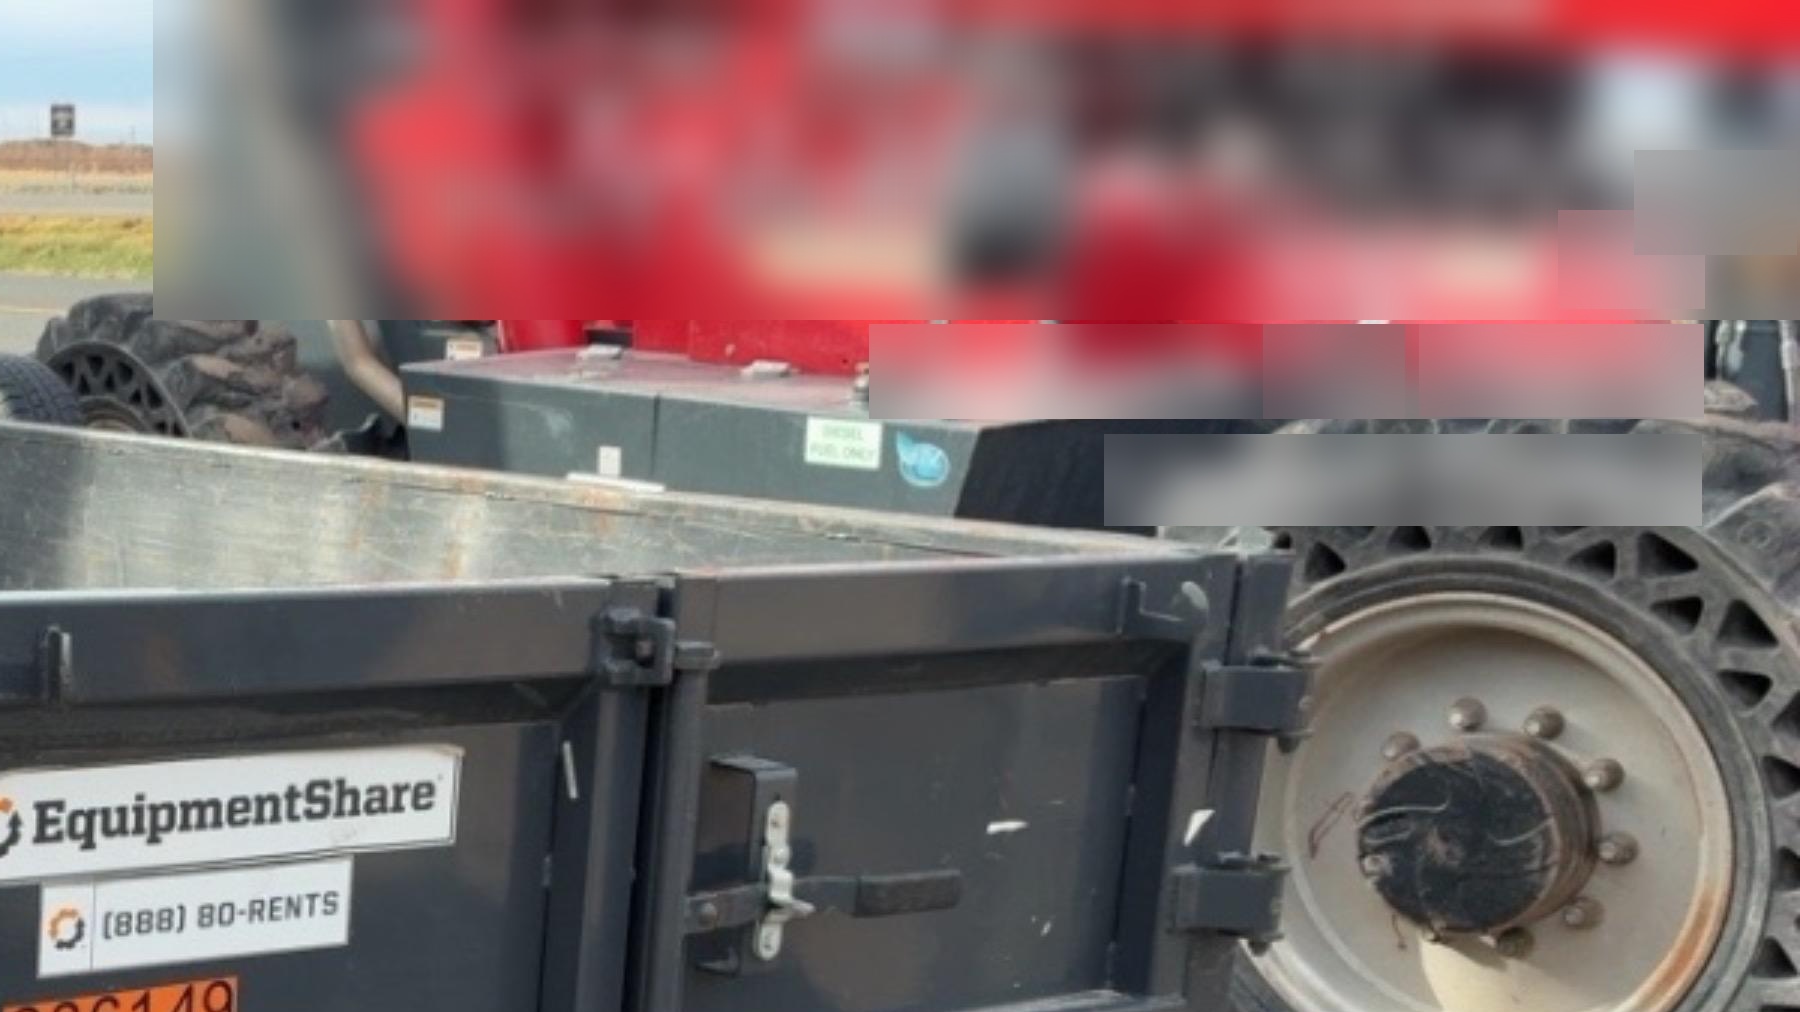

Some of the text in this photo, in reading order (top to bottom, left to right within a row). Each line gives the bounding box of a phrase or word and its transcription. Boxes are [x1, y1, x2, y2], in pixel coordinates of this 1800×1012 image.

[32, 779, 436, 851] EquipmentShare
[102, 890, 340, 939] (888) 80-RENTS
